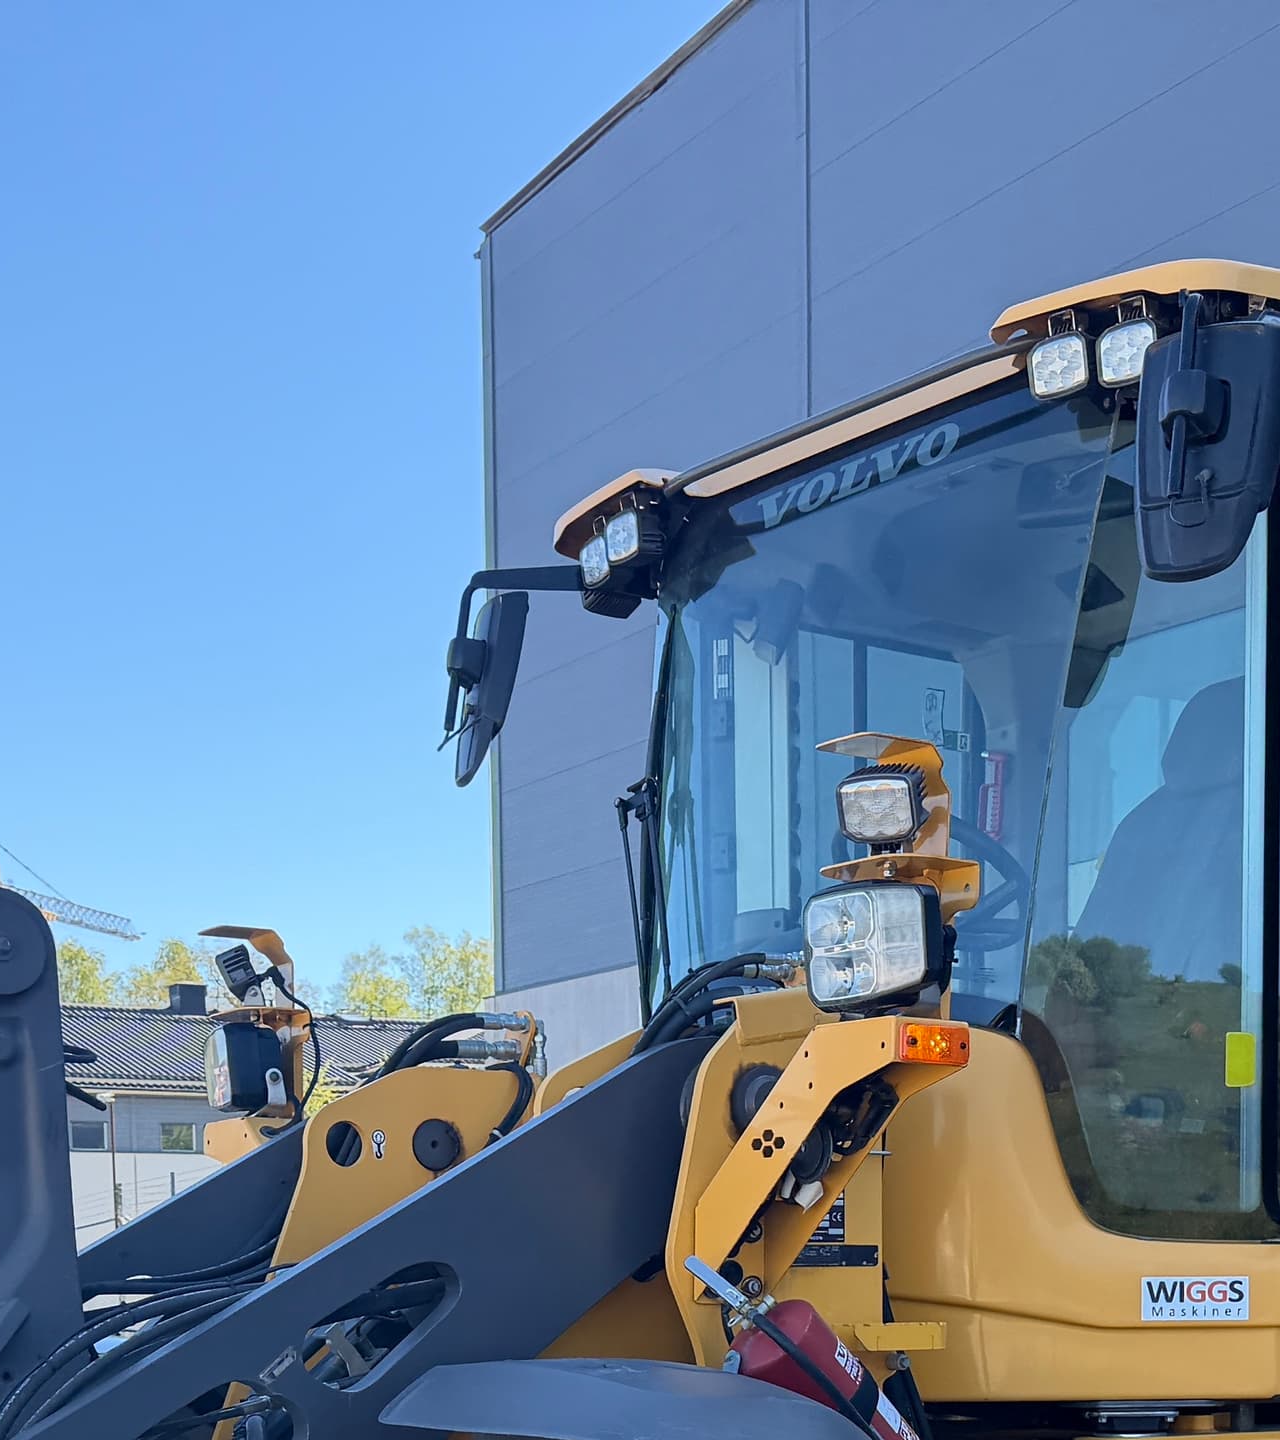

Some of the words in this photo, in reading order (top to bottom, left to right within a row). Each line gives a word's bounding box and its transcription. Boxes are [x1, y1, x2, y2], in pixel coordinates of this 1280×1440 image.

[756, 422, 961, 529] VOLVO
[1146, 1279, 1245, 1303] WIGGS
[1151, 1305, 1243, 1318] Maskiner
